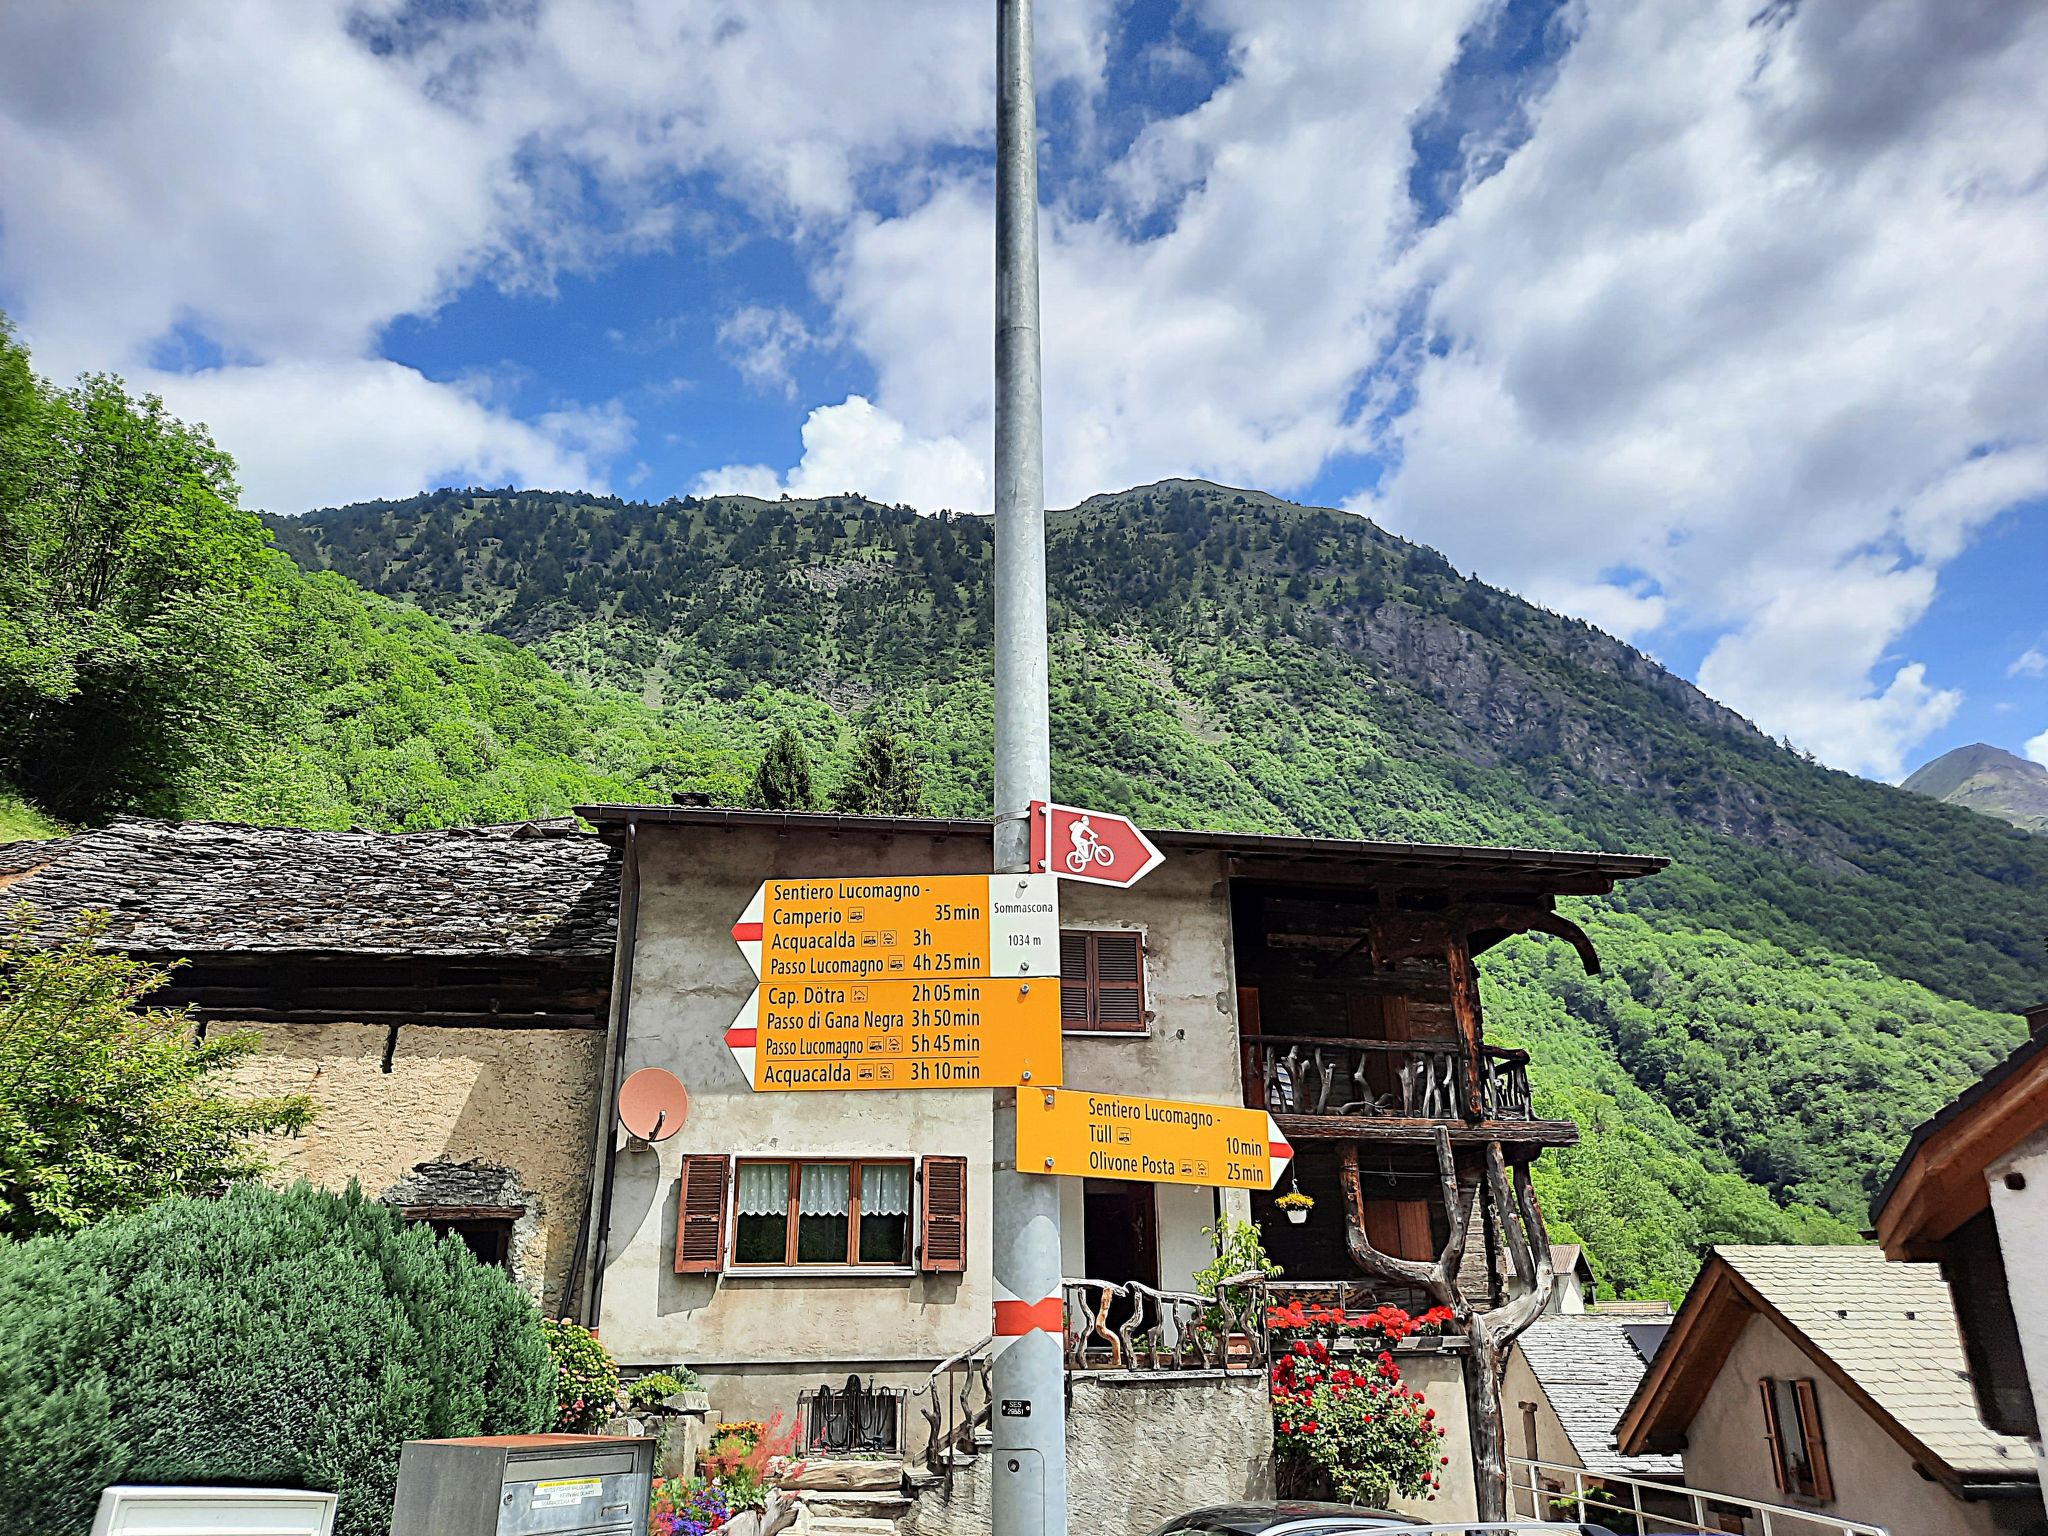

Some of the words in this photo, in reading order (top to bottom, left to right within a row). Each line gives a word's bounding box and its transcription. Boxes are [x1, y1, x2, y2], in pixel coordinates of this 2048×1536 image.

[774, 884, 834, 900] Sentiero
[839, 882, 919, 899] Lucomagno
[773, 908, 842, 928] Camperio
[994, 902, 1053, 914] Sommascona
[772, 930, 855, 953] Acquacalda
[1008, 934, 1030, 947] 1034
[1033, 936, 1042, 946] m
[771, 958, 806, 975] Passo
[811, 957, 884, 976] Lucomagno
[769, 988, 800, 1008] Cap.
[805, 986, 845, 1004] Dötra
[767, 1013, 804, 1030] Passo
[808, 1011, 820, 1029] di
[824, 1011, 859, 1029] Gana
[864, 1010, 904, 1032] Negra
[766, 1038, 796, 1056] Passo
[800, 1037, 864, 1058] Lucomagno
[764, 1062, 851, 1087] Acquacalda
[1088, 1097, 1141, 1120] Sentiero
[1145, 1104, 1213, 1130] Lucomagno
[1088, 1124, 1112, 1143] Tüll
[1089, 1151, 1138, 1173] Olivone
[1142, 1156, 1175, 1175] Posta
